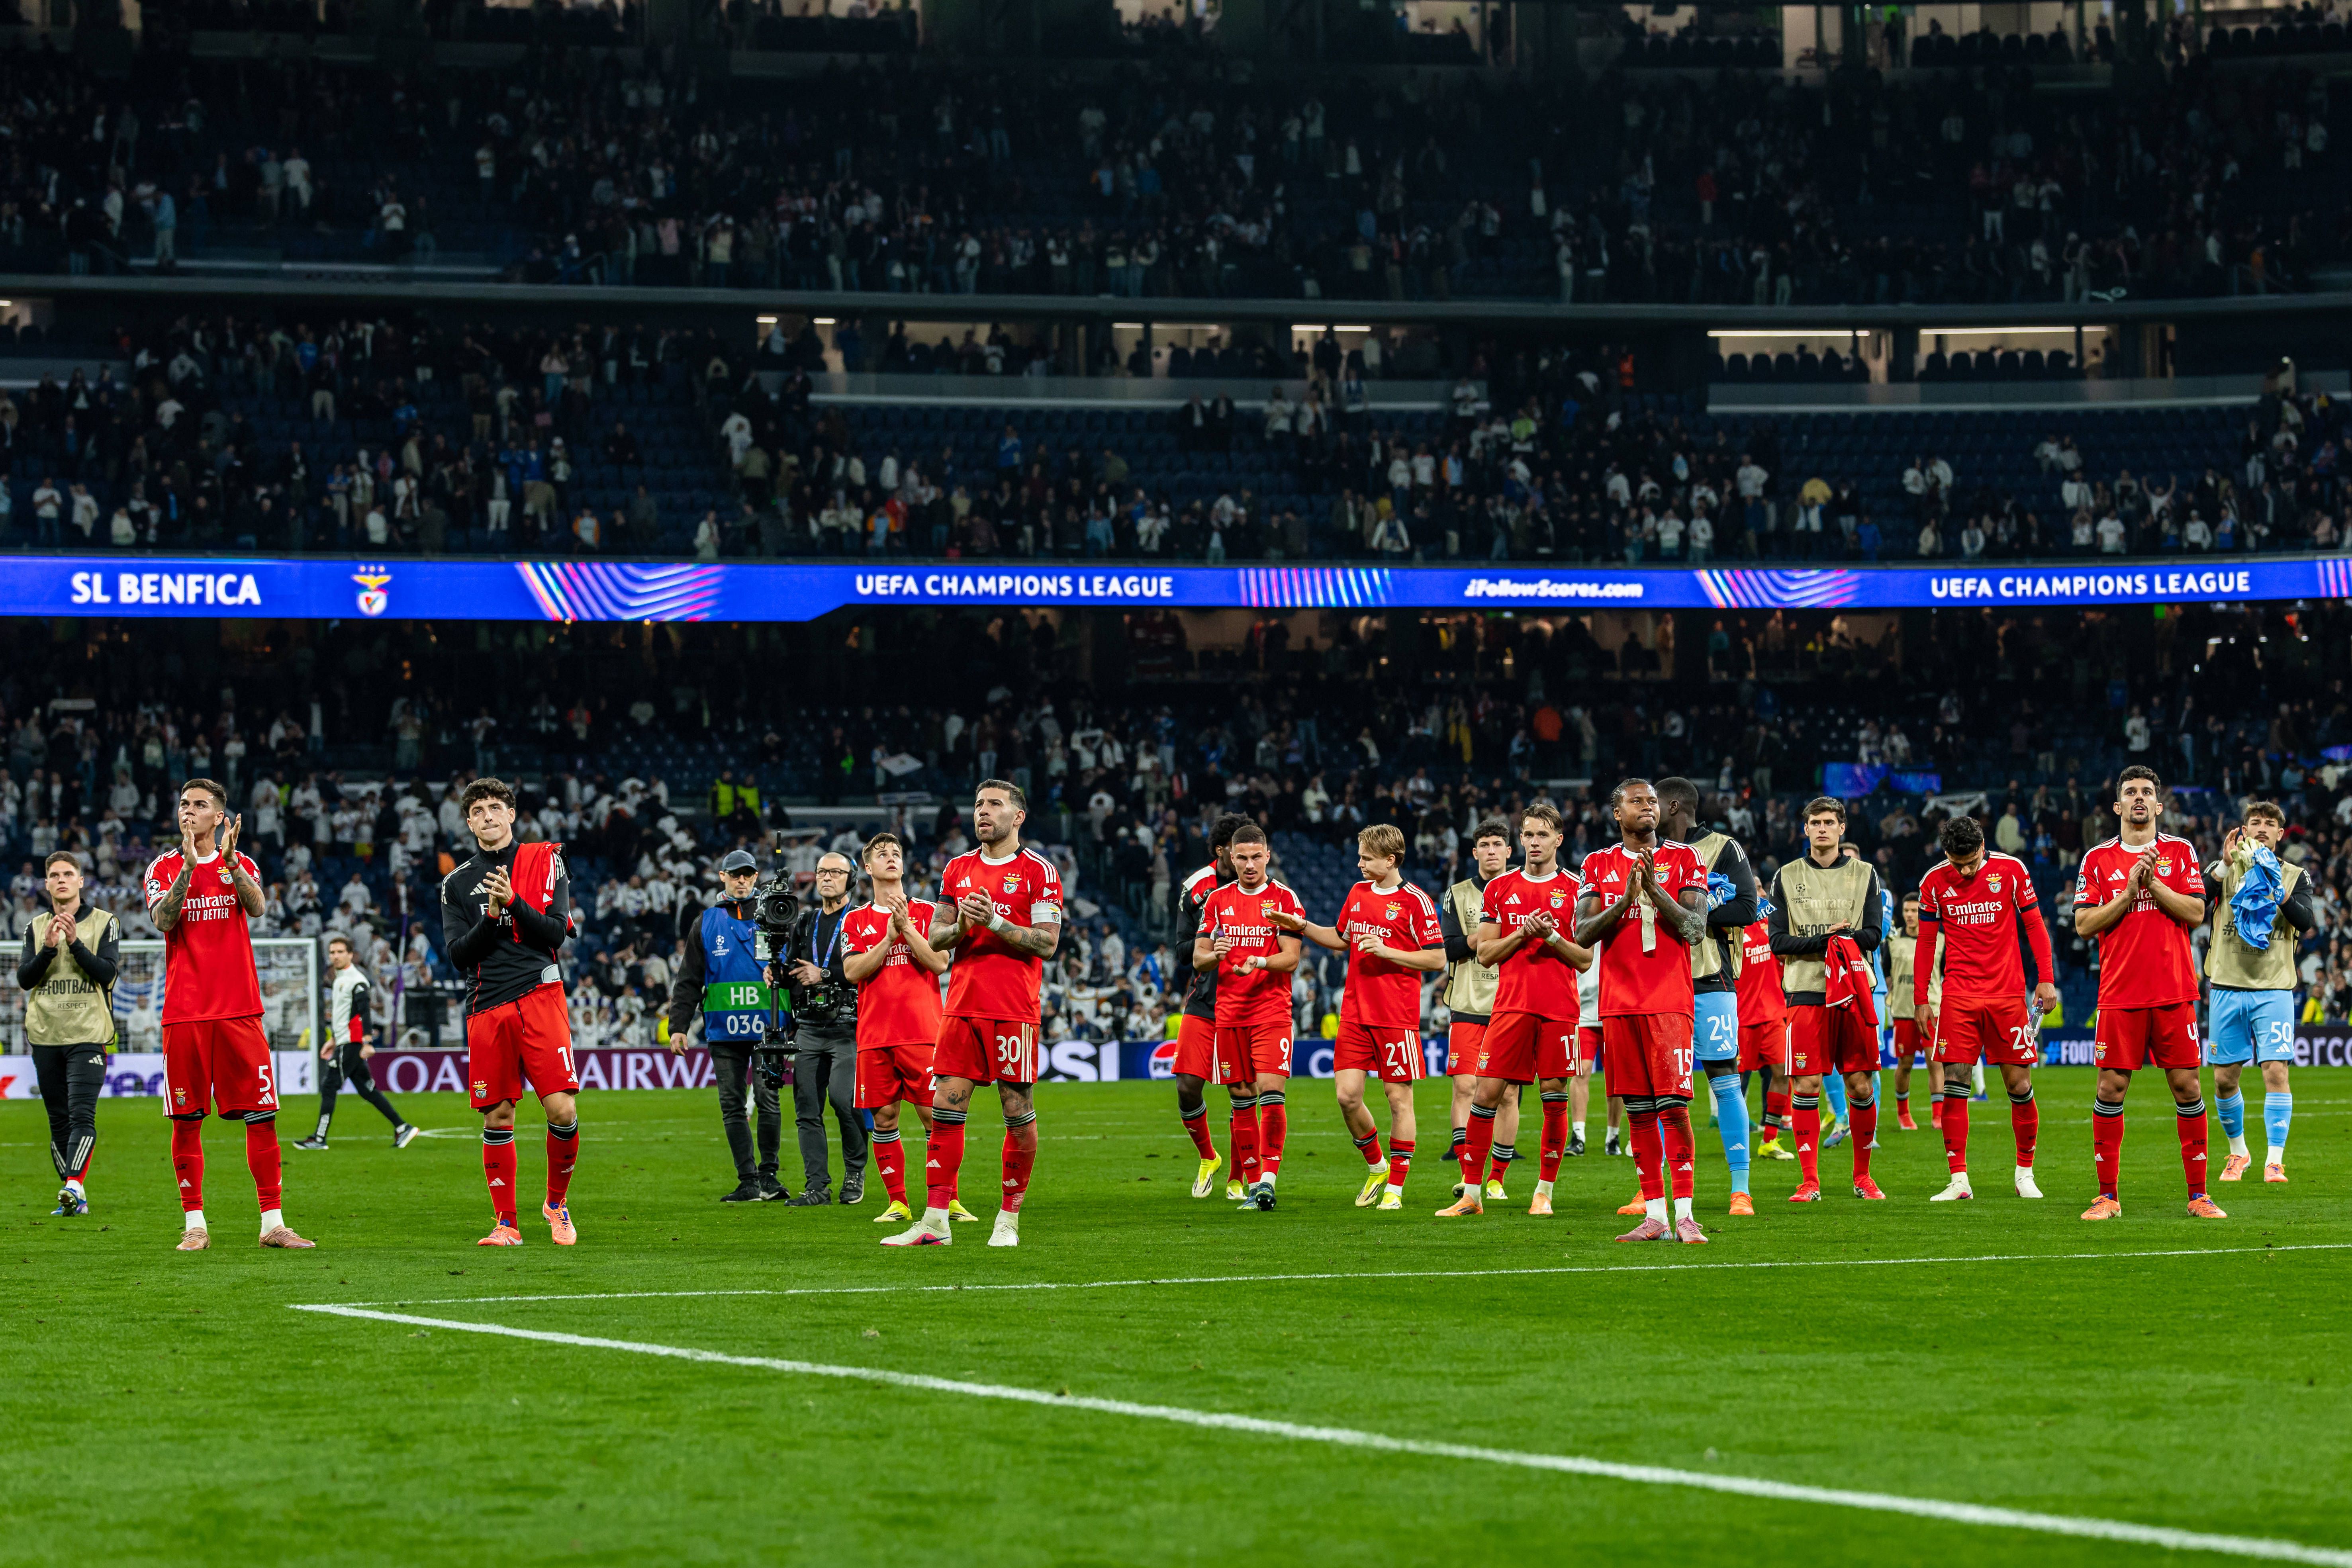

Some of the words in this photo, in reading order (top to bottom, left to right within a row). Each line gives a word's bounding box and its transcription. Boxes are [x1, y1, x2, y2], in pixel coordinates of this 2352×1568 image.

[71, 572, 111, 603] SL
[119, 574, 261, 605] BENFICA
[856, 575, 919, 595] UEFA
[924, 575, 1072, 596] CHAMPIONS
[1079, 576, 1173, 597] LEAGUE
[1931, 577, 1993, 597] UEFA
[1999, 574, 2148, 597] CHAMPIONS
[2154, 572, 2250, 593] LEAGUE
[188, 910, 200, 921] FLY
[203, 908, 229, 920] BETTER
[1946, 901, 2002, 916] Emirates
[1957, 916, 1968, 925] FLY
[1970, 913, 1995, 924] BETTER
[1222, 924, 1273, 936] Emirates
[1350, 920, 1392, 938] Emirates
[1241, 937, 1265, 947] BETTER
[886, 954, 909, 966] BETTER
[730, 986, 760, 1006] HB
[726, 1014, 765, 1035] 036
[1706, 1013, 1733, 1041] 24
[2270, 1021, 2293, 1043] 50
[996, 1036, 1021, 1063] 30
[1279, 1038, 1290, 1060] 9
[1385, 1041, 1408, 1067] 21
[1672, 1048, 1692, 1077] 15
[258, 1065, 271, 1092] 5
